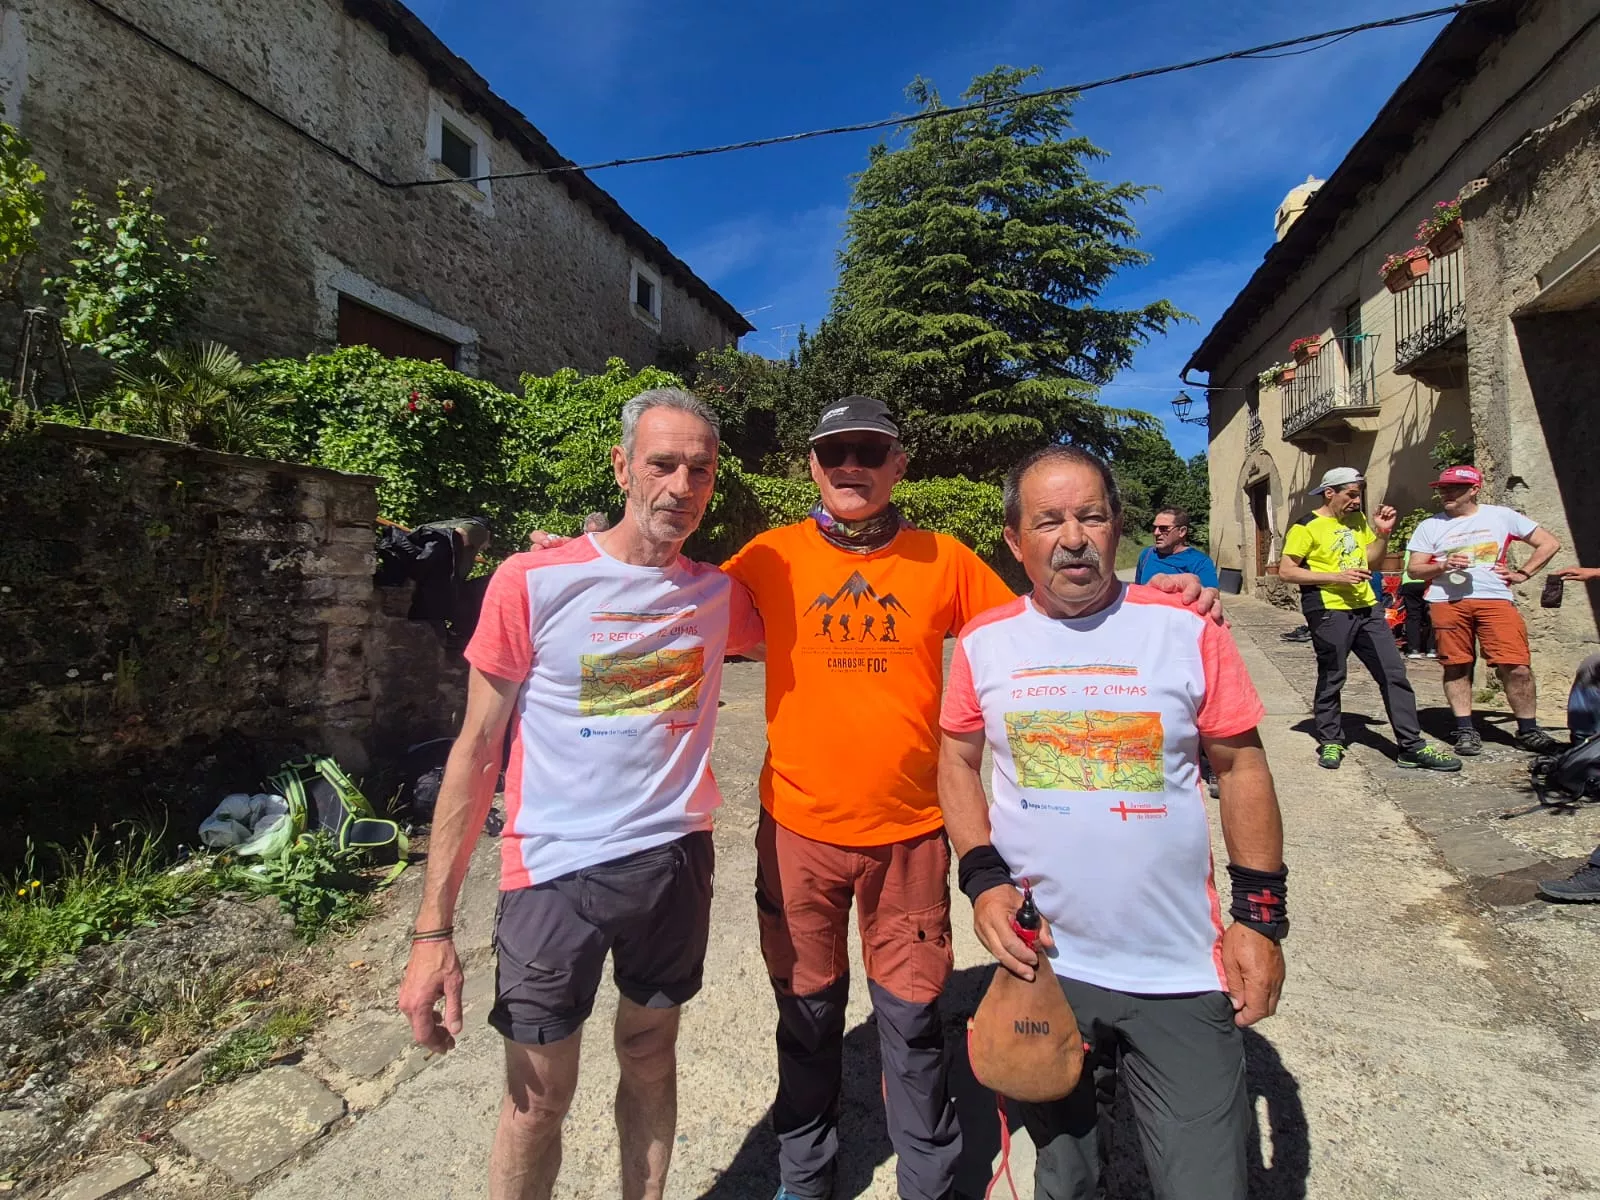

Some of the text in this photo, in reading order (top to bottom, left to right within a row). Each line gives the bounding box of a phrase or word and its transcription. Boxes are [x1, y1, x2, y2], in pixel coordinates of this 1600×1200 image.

[591, 632, 604, 642] 12
[609, 632, 647, 642] RETOS
[827, 657, 858, 668] CARROS
[867, 657, 888, 673] FOC
[1012, 689, 1023, 699] 12
[1027, 685, 1068, 697] RETOS
[1082, 685, 1099, 697] 12
[1103, 684, 1148, 696] CIMAS
